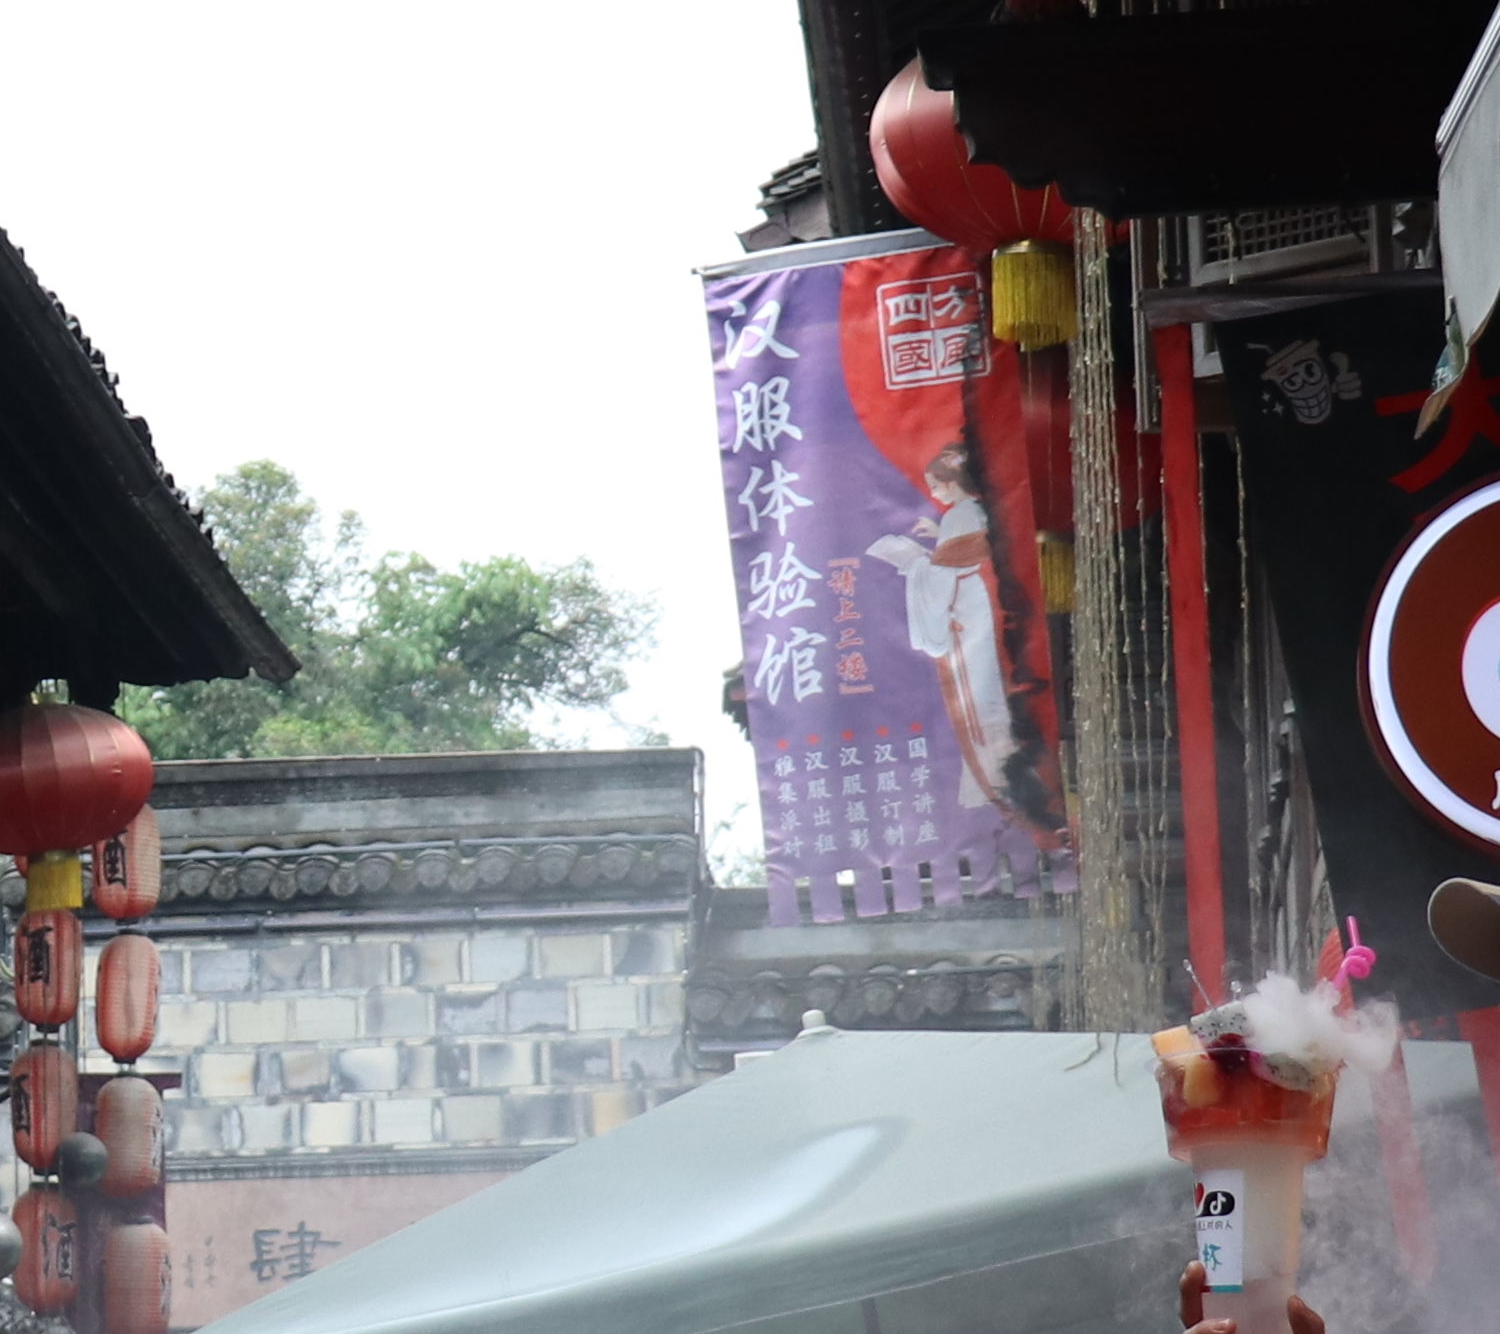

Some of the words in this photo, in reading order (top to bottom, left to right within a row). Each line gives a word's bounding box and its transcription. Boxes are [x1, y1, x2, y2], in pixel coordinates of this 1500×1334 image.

[724, 298, 829, 707] 汉服体验馆
[804, 751, 838, 855] 汉服出租
[839, 746, 870, 851] 汉服摄影
[874, 743, 905, 846] 汉服订制
[907, 736, 939, 845] 国学讲座
